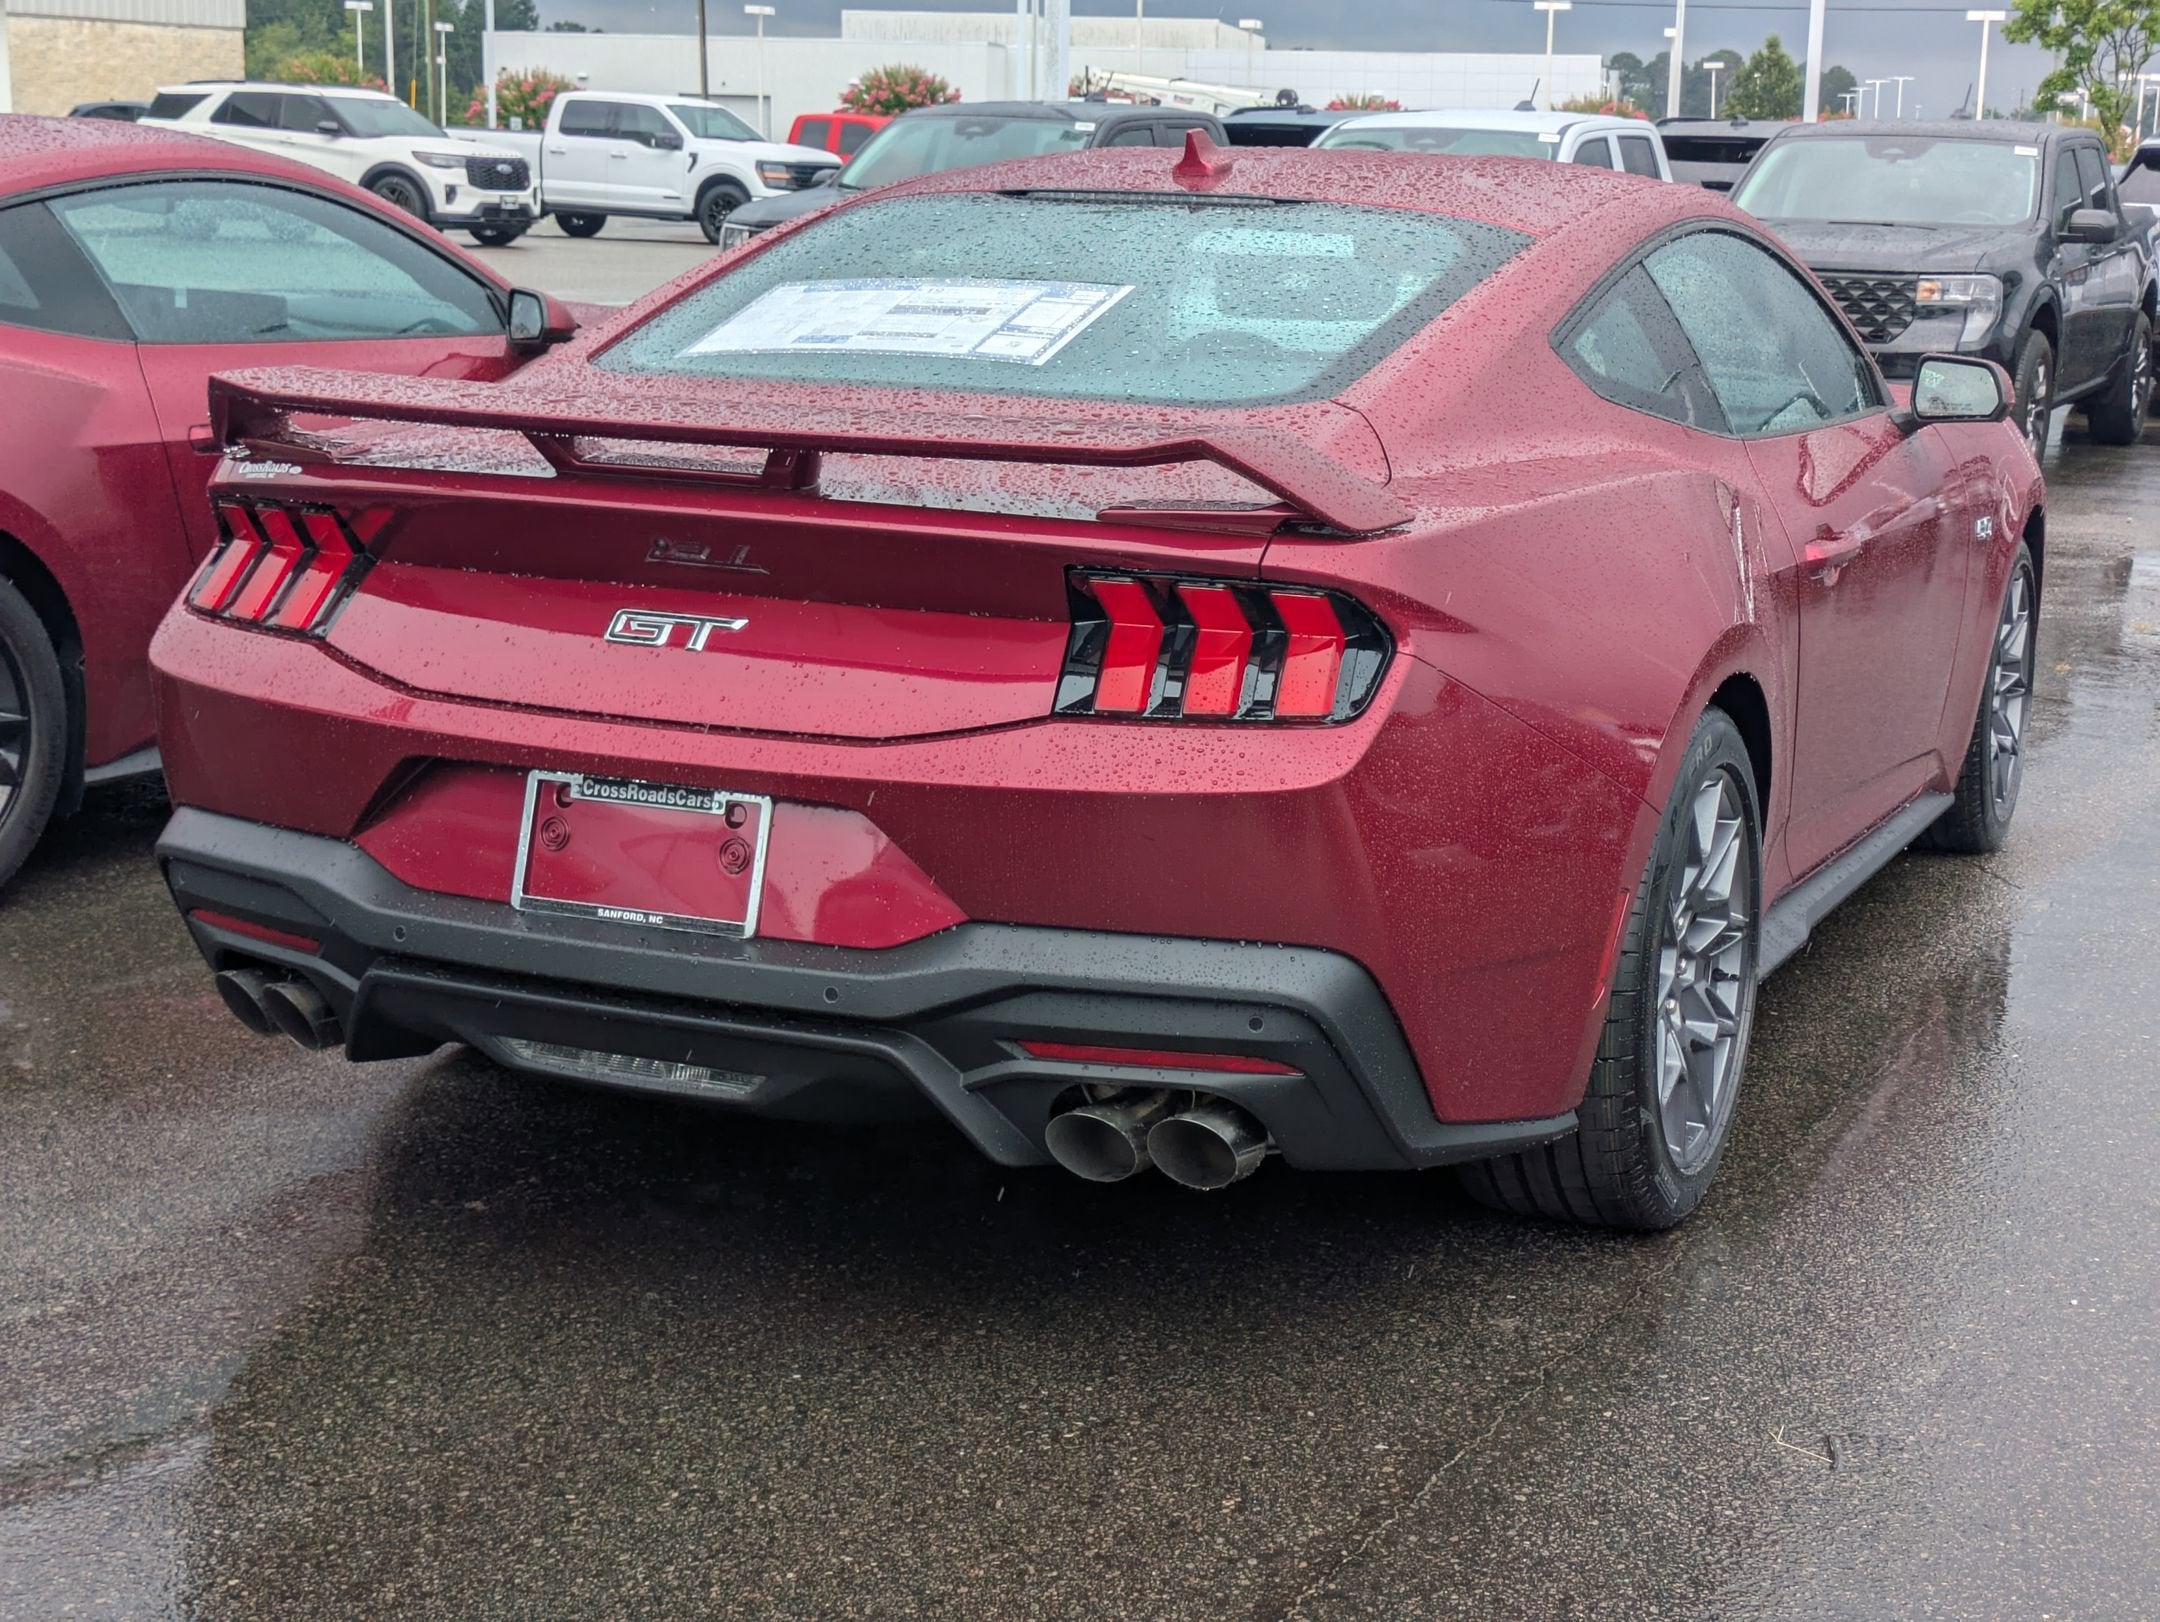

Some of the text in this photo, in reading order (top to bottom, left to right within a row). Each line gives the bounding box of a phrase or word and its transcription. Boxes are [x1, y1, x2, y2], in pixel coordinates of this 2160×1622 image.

[604, 608, 749, 651] GT
[582, 779, 713, 809] CrossRoadsCars
[597, 908, 664, 925] SANFORD, NC
